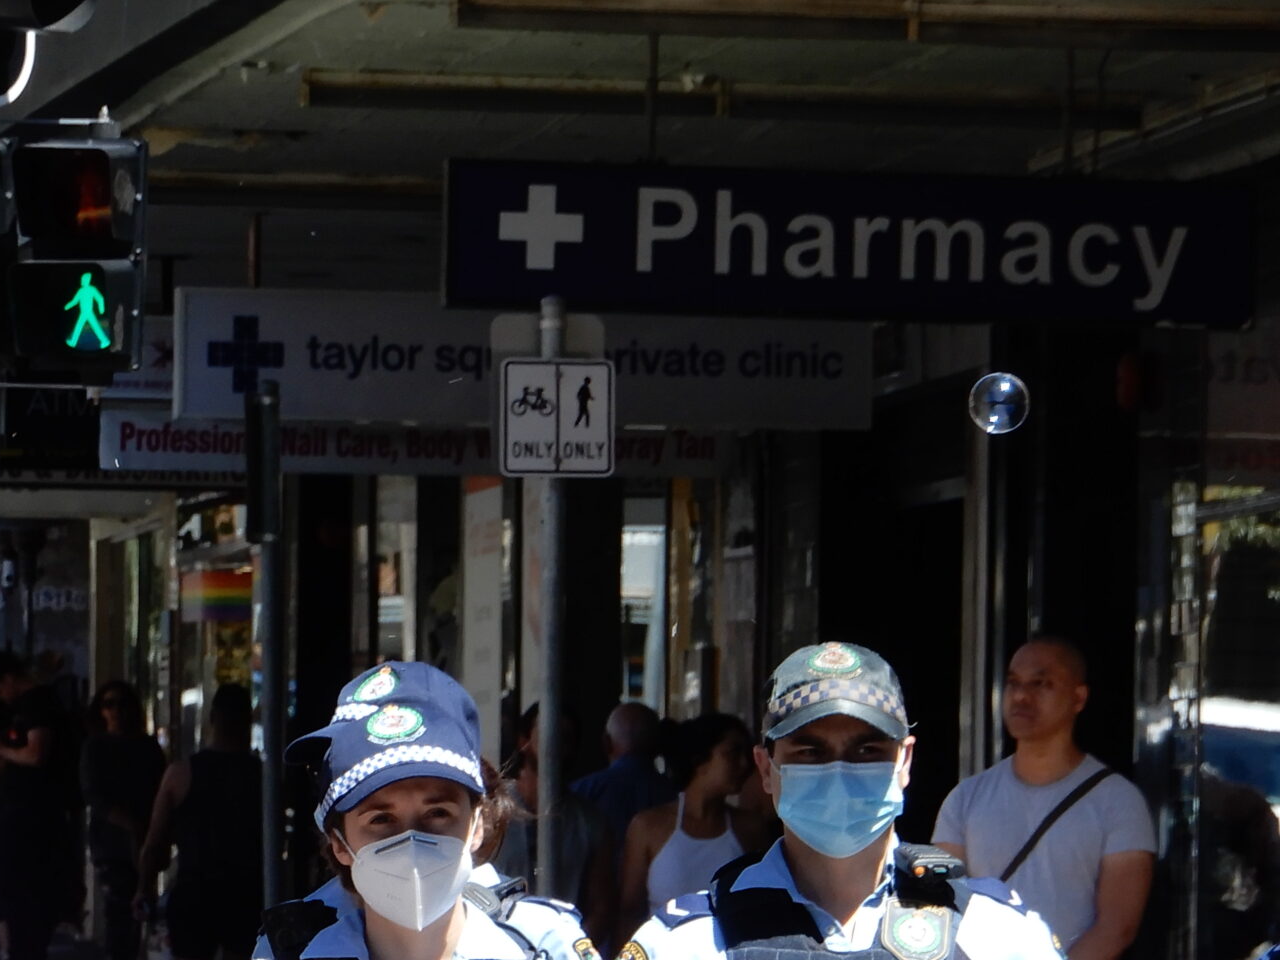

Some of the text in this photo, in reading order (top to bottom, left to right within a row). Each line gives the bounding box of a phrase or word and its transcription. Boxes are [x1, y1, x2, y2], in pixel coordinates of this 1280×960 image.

[634, 185, 1189, 314] Pharmacy
[308, 335, 423, 379] taylor
[605, 339, 726, 378] rivate
[738, 342, 844, 379] clinic
[119, 422, 250, 455] Profession
[280, 426, 327, 457] Nail
[335, 428, 399, 465] Care,
[406, 429, 466, 465] Body
[672, 429, 715, 459] Tan
[511, 441, 553, 458] ONLY
[563, 441, 605, 459] ONLY
